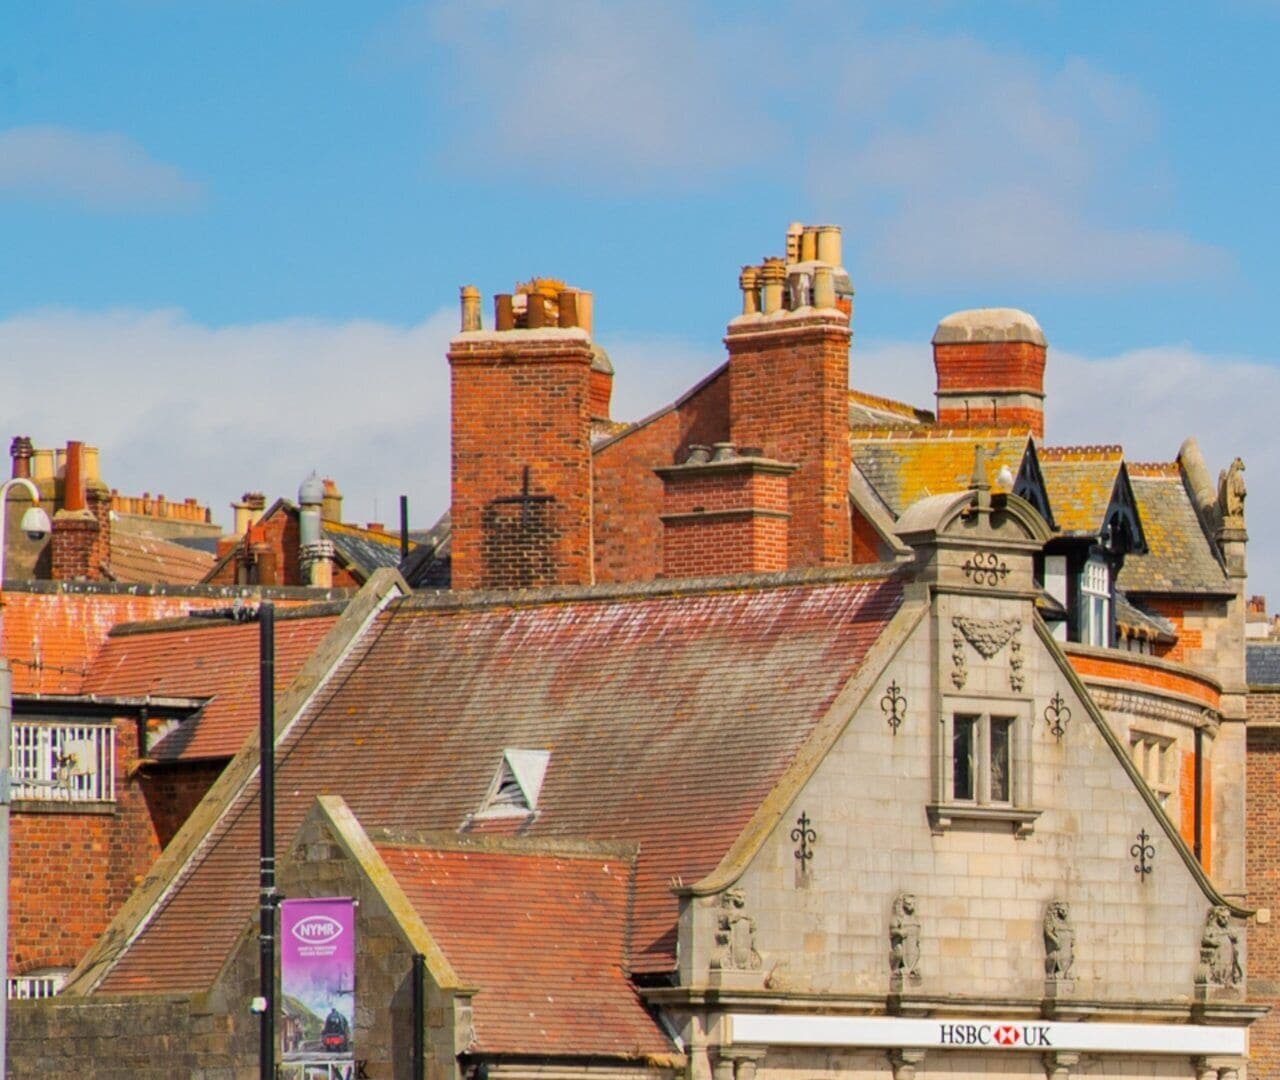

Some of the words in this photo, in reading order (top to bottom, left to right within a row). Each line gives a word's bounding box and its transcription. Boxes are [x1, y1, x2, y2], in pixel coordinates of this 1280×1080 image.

[300, 923, 334, 937] NYMR
[940, 1024, 991, 1045] HSBC
[1023, 1026, 1051, 1046] UK
